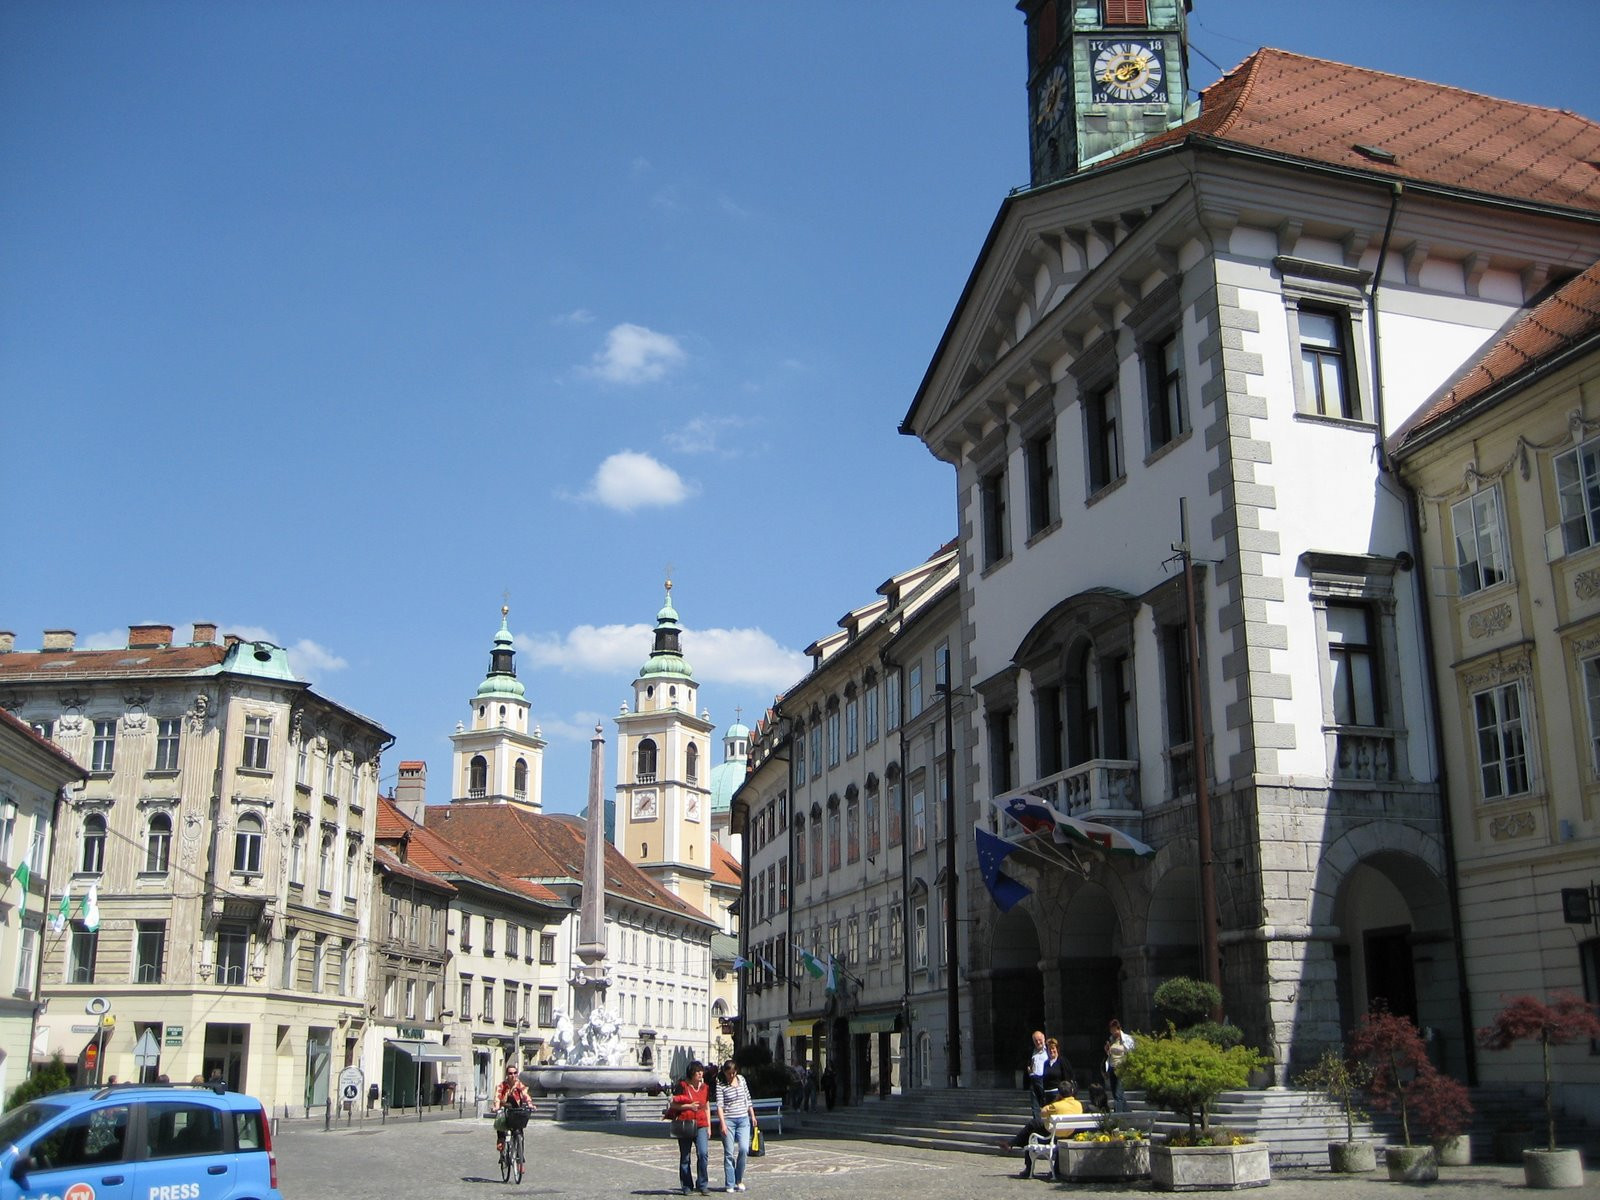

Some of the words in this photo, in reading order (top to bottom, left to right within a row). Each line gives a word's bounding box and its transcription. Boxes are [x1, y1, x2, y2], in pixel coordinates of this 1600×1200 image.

[1091, 41, 1104, 51] 17
[1149, 41, 1162, 50] 18
[1095, 93, 1108, 102] 19
[1151, 93, 1166, 102] 28
[70, 1191, 91, 1200] TV
[150, 1183, 200, 1200] PRESS
